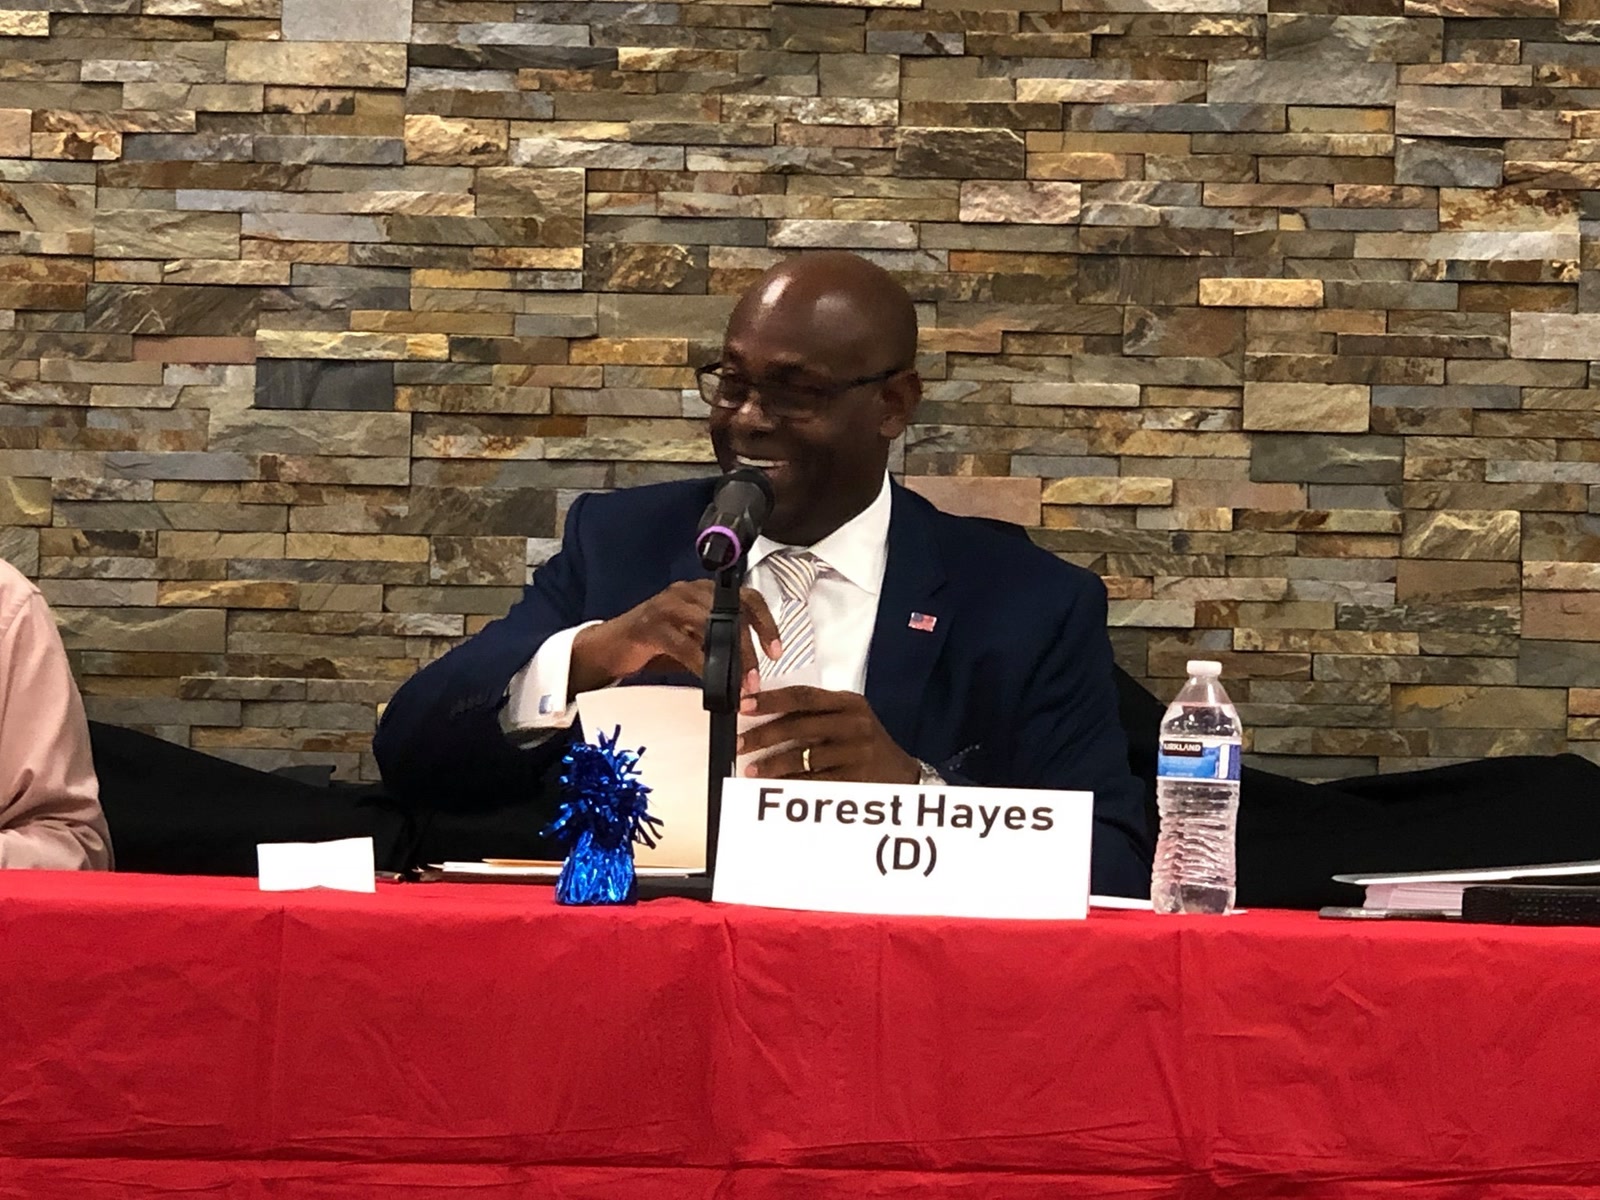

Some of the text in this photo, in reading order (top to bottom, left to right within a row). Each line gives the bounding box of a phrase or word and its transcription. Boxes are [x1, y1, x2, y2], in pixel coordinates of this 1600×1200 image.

[757, 787, 1054, 838] Forest Hayes
[876, 834, 937, 877] (D)
